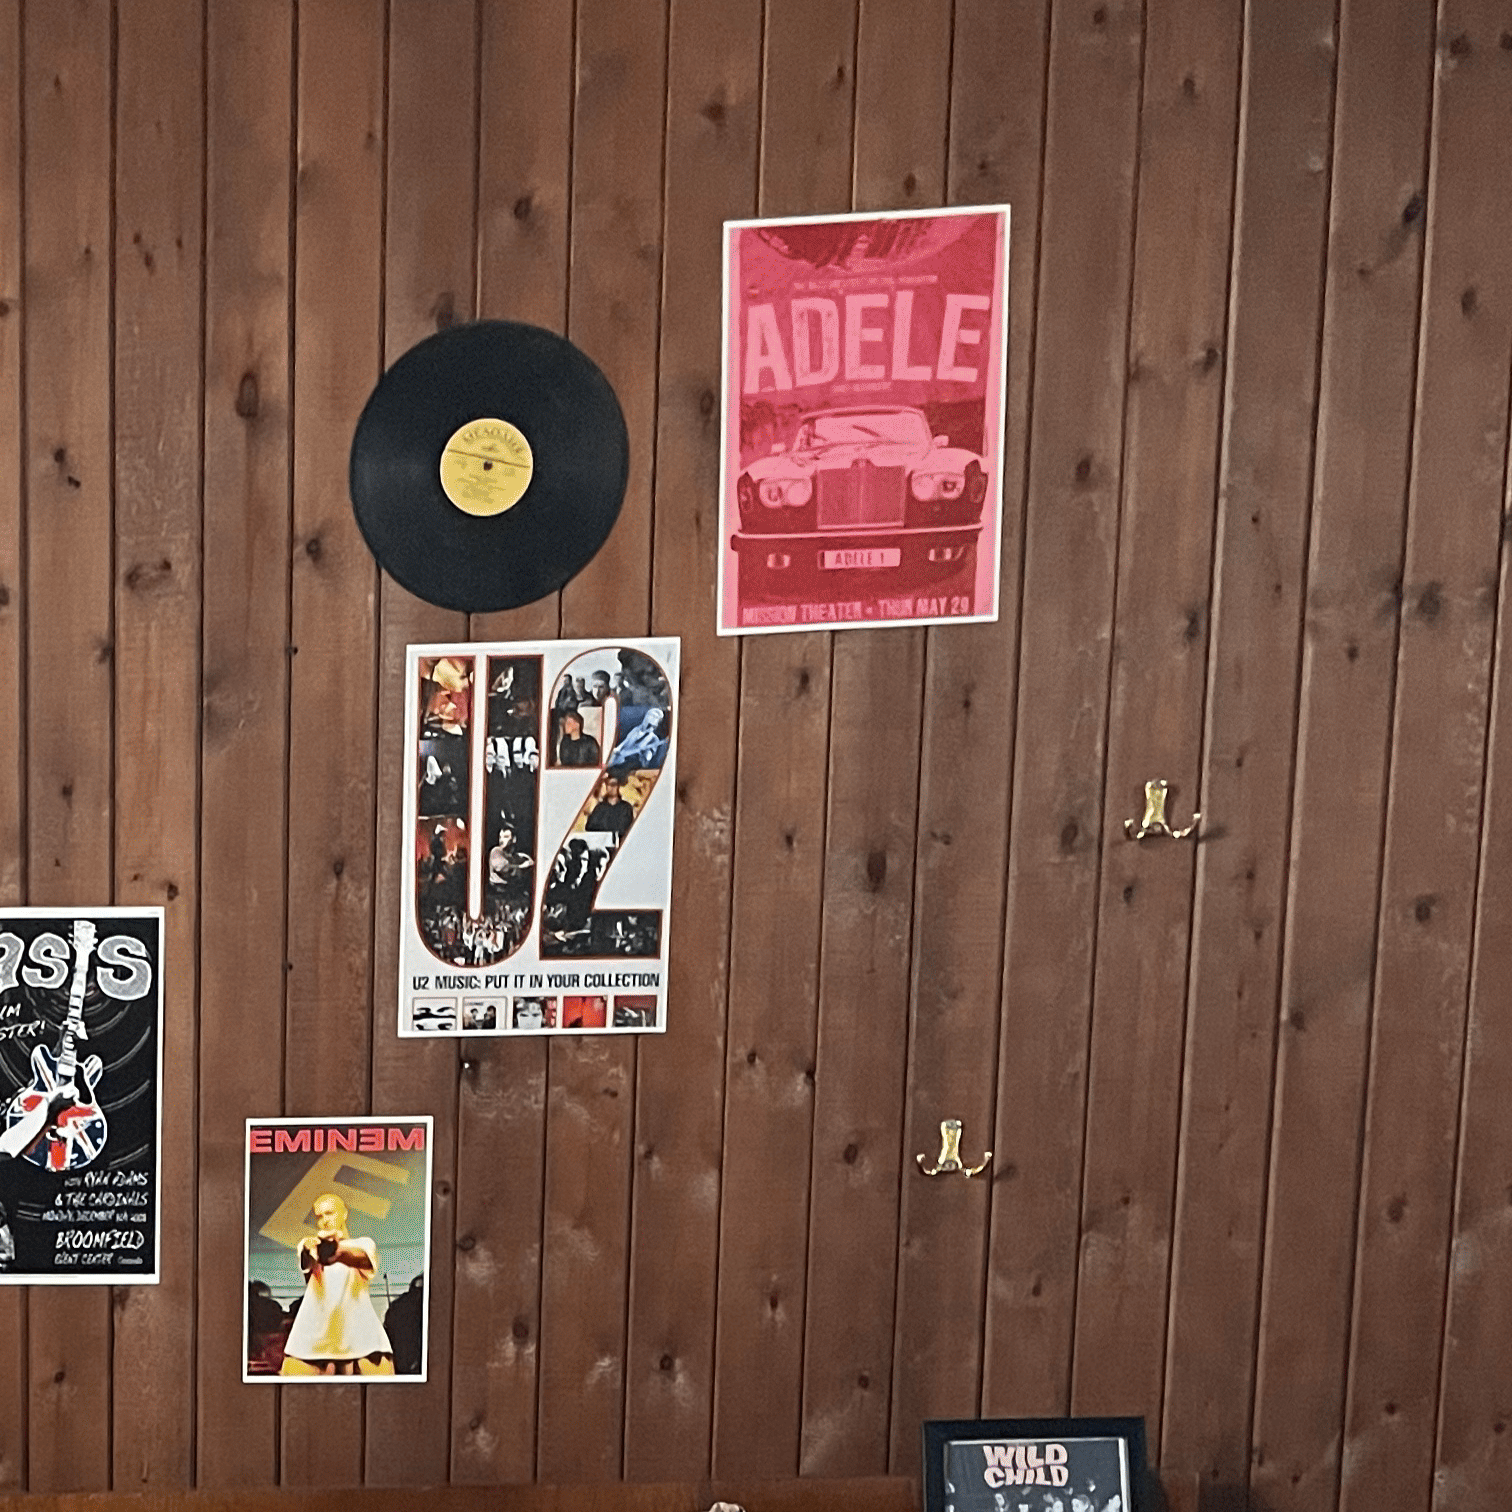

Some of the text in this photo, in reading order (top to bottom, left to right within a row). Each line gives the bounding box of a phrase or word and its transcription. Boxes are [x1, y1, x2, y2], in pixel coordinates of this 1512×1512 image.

[744, 291, 990, 394] ADELE
[415, 646, 672, 967] U2
[412, 973, 660, 990] U2 MUSIC: PUT IT IN YOUR COLLECTION
[250, 1128, 424, 1152] EMINEM
[55, 1229, 144, 1249] BROOMFIELD
[982, 1443, 1068, 1469] WILD
[984, 1465, 1069, 1489] CHILD
